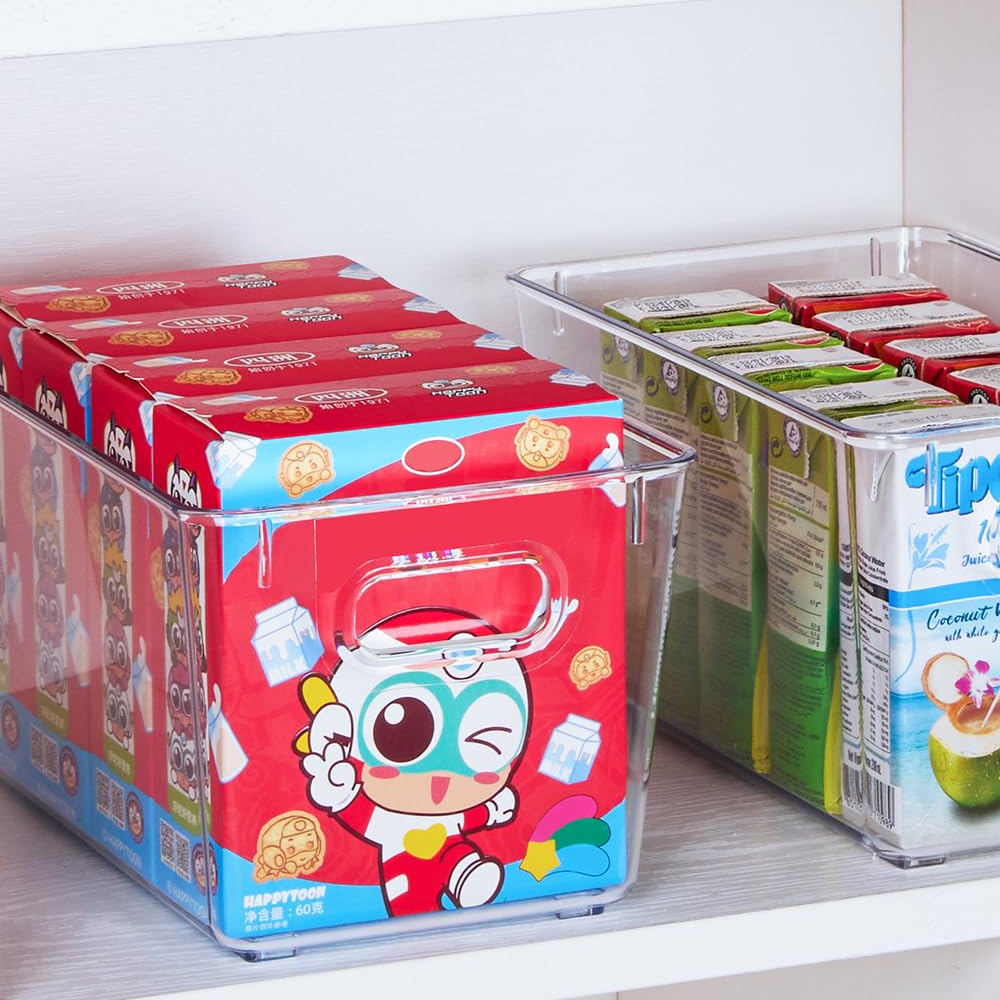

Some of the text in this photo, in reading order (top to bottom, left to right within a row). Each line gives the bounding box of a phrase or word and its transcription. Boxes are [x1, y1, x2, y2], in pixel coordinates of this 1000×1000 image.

[926, 605, 994, 630] Coconut
[966, 626, 991, 639] white
[243, 885, 327, 909] HAPPYTOON
